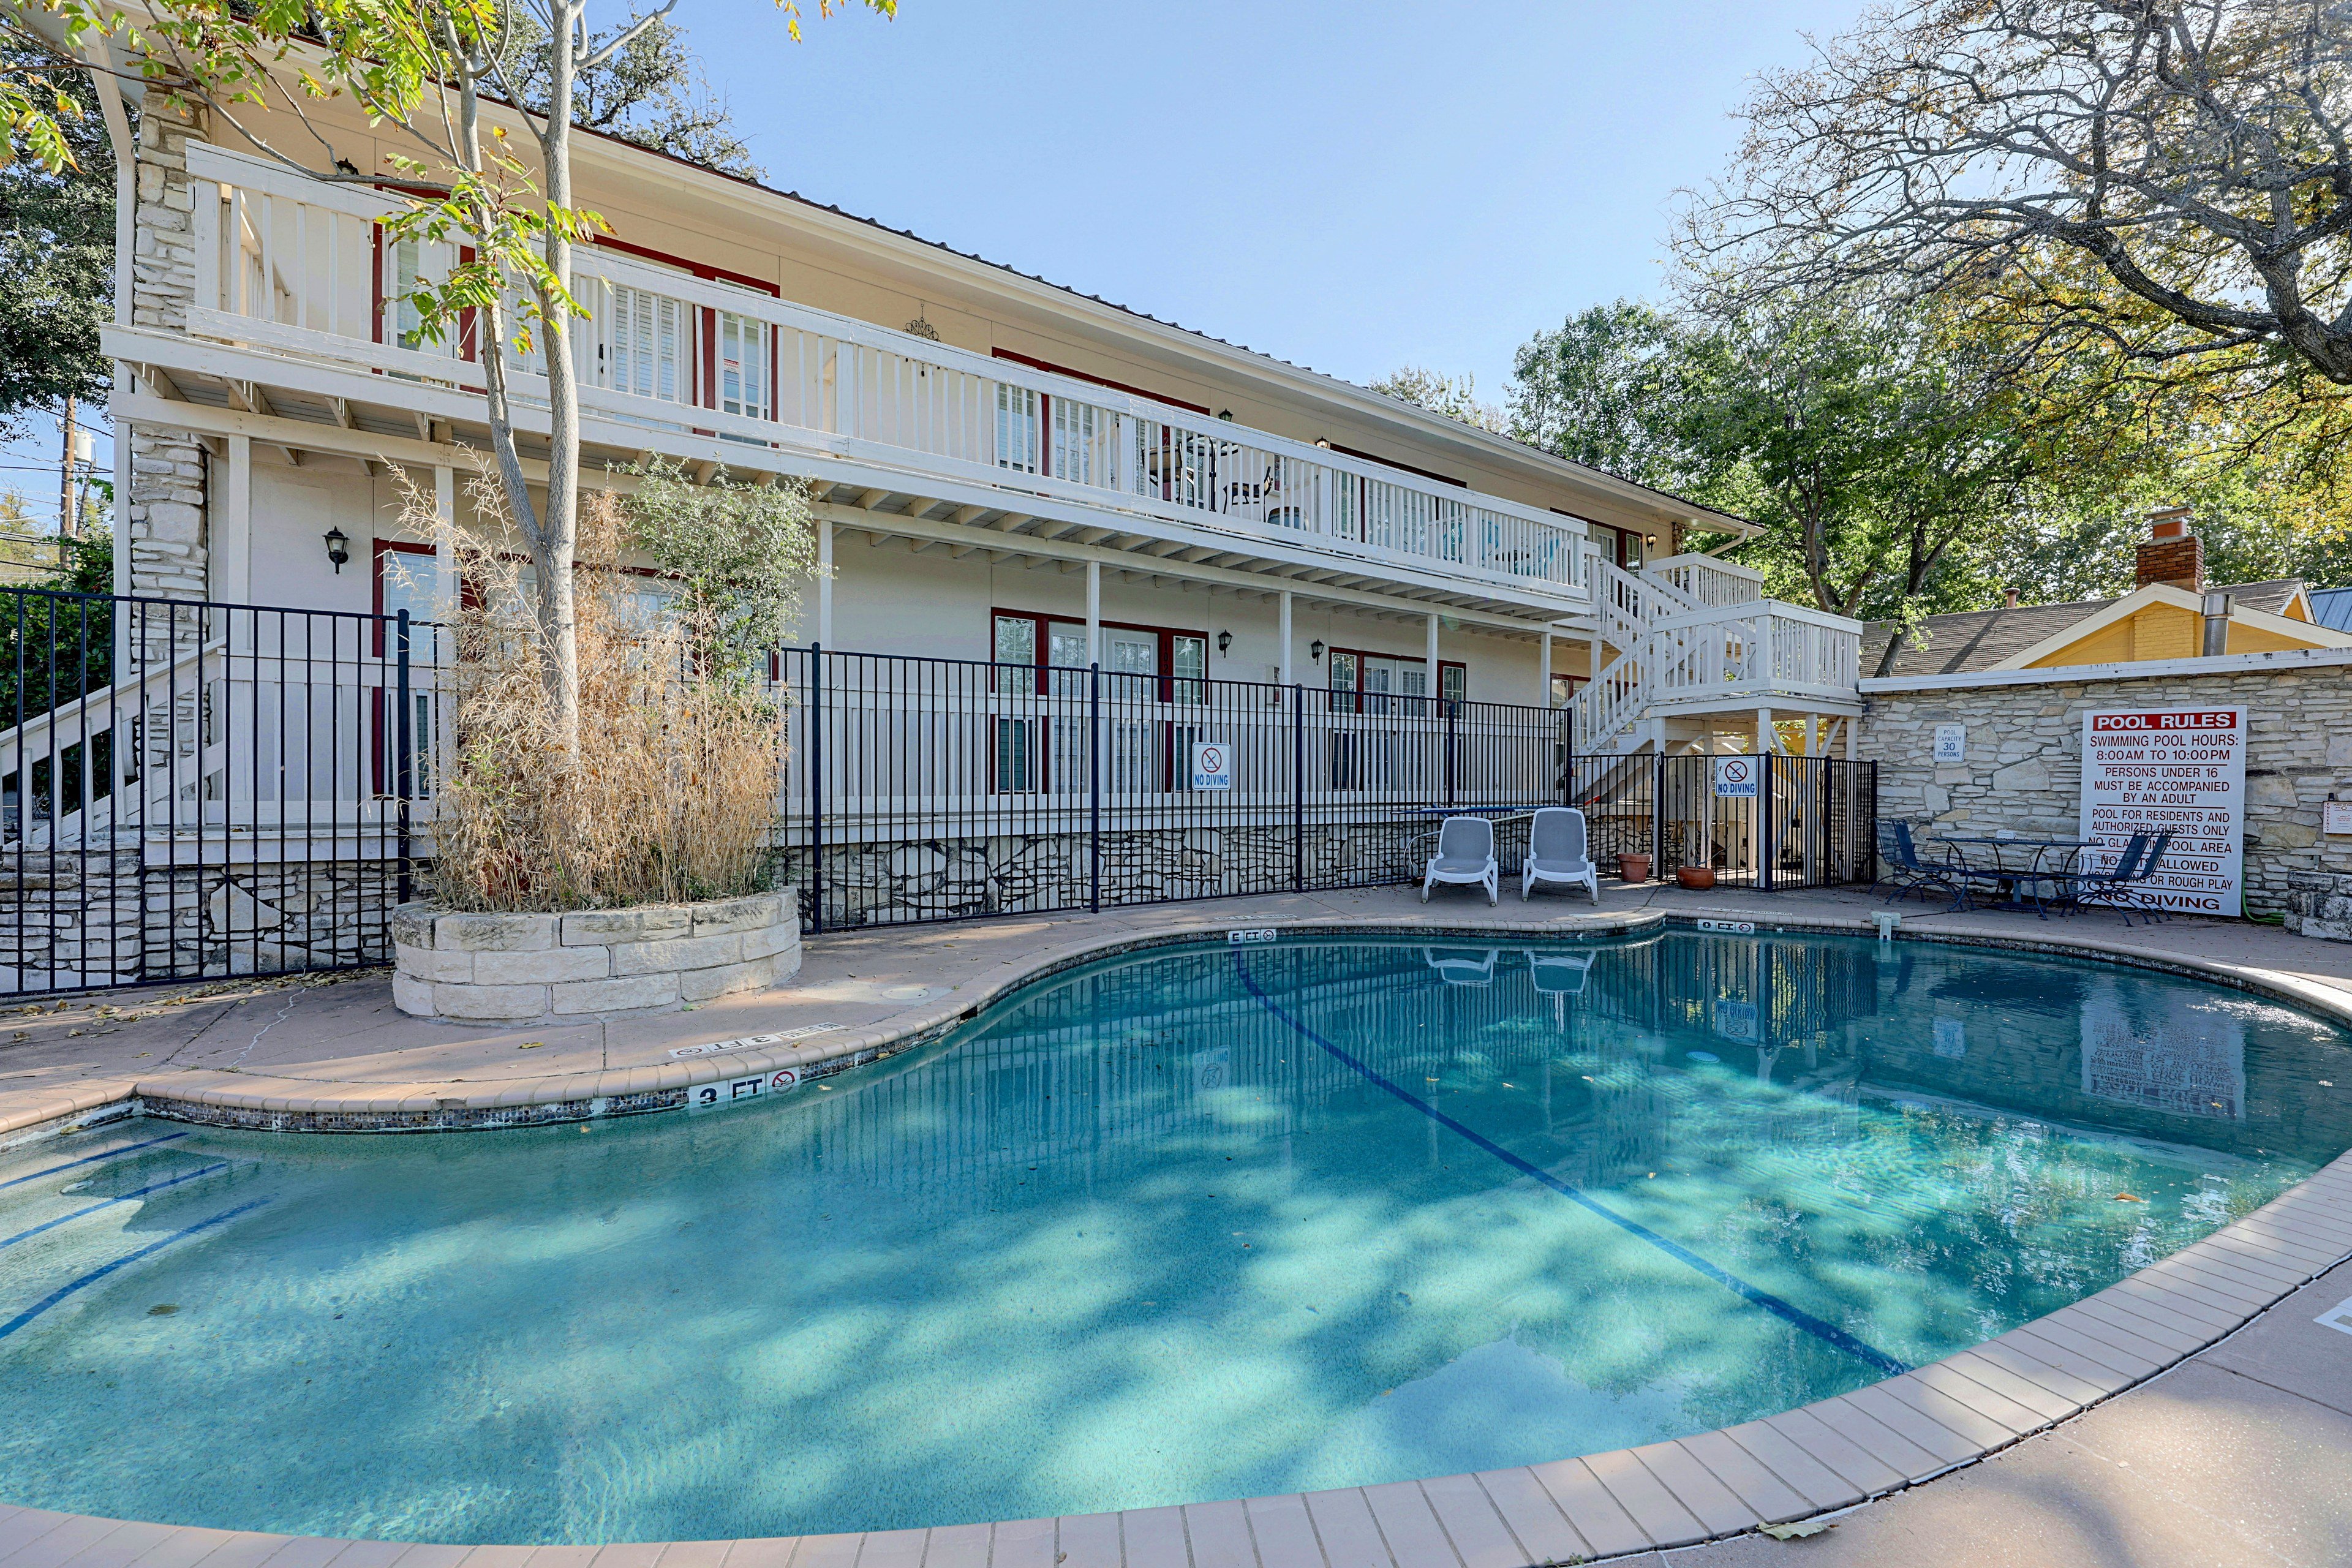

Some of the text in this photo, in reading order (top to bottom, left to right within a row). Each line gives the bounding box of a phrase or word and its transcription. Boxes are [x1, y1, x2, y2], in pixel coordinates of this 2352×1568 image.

[2098, 714, 2230, 729] POOL RULES
[2090, 734, 2238, 747] SWIMMING POOL HOURS:
[2150, 750, 2166, 760] TO
[2105, 767, 2218, 778] PERSONS UNDER 16
[1195, 774, 1228, 786] NO DIVING
[1718, 783, 1755, 793] NO DIVING
[2095, 781, 2230, 792] MUST BE ACCOMPANIED
[2123, 793, 2196, 804] BY AN ADULT
[2092, 809, 2230, 823] POOL FOR RESIDENTS AND
[2092, 821, 2230, 836] AUTHORIZED GUESTS ONLY
[2165, 841, 2195, 851] POOL
[2200, 842, 2232, 853] AREA
[2101, 855, 2117, 865] NO
[2158, 859, 2218, 872] ALLOWED
[2150, 875, 2164, 885] OR
[2168, 876, 2204, 888] ROUGH
[2208, 879, 2233, 890] PLAY
[2098, 891, 2220, 910] NO DIVING
[714, 1041, 743, 1050] FT
[699, 1078, 763, 1104] 3 FT
